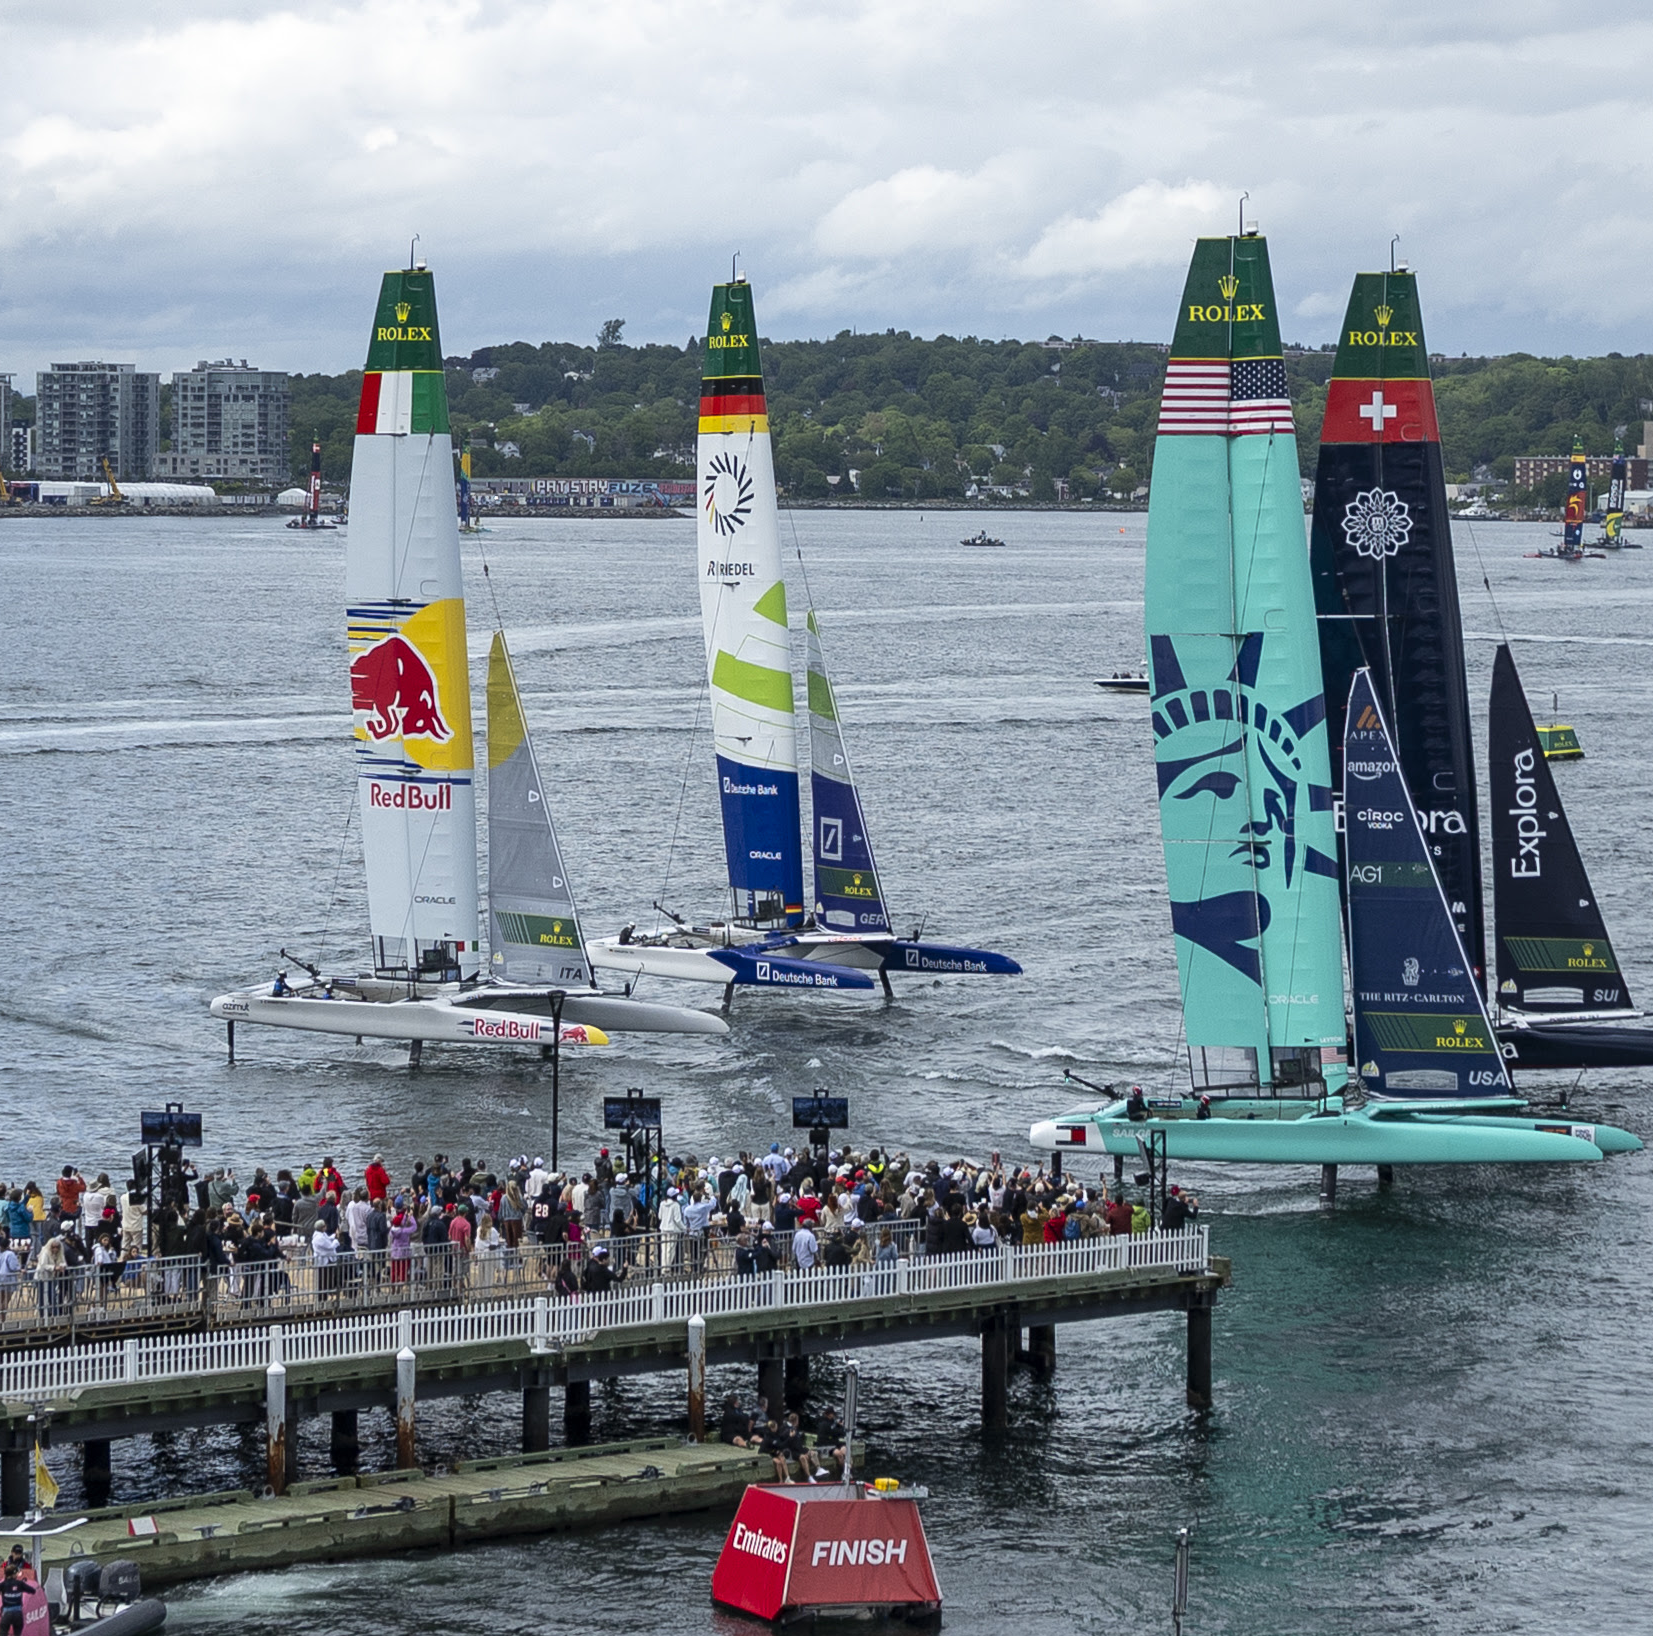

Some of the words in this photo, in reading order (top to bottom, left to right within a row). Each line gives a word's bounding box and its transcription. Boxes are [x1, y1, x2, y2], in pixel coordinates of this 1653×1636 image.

[1188, 304, 1266, 322] ROLEX
[377, 327, 432, 342] ROLEX
[708, 334, 749, 349] ROLEX
[1348, 331, 1418, 346] ROLEX
[536, 480, 565, 494] PAT
[570, 480, 608, 494] STAY
[719, 562, 755, 577] RIEDEL
[1349, 730, 1386, 741] APEX
[1348, 761, 1399, 773] amazon
[370, 783, 405, 808] Red
[408, 784, 452, 810] Bull
[731, 784, 756, 795] Deutsche
[758, 785, 778, 796] Bank
[1357, 808, 1404, 823] CÎROC
[1509, 748, 1548, 878] Explora
[750, 851, 782, 860] ORACLE
[1349, 865, 1383, 884] AG1
[844, 886, 873, 897] ROLEX
[414, 895, 456, 905] ORACLE
[860, 913, 884, 926] GER
[540, 933, 573, 946] ROLEX
[921, 956, 961, 972] Deutsche
[964, 960, 987, 973] Bank
[1568, 957, 1608, 968] ROLEX
[559, 967, 583, 981] ITA
[772, 970, 813, 985] Deutsche
[815, 974, 838, 987] Bank
[1268, 994, 1319, 1005] ORACLE
[1360, 992, 1382, 1003] THE
[1593, 989, 1620, 1003] SUI
[474, 1018, 506, 1037] Red
[508, 1021, 540, 1039] Bull
[1436, 1037, 1484, 1049] ROLEX
[1468, 1070, 1507, 1087] USA
[535, 1203, 549, 1218] 28
[732, 1522, 788, 1564] Emirates
[811, 1539, 908, 1567] FINISH
